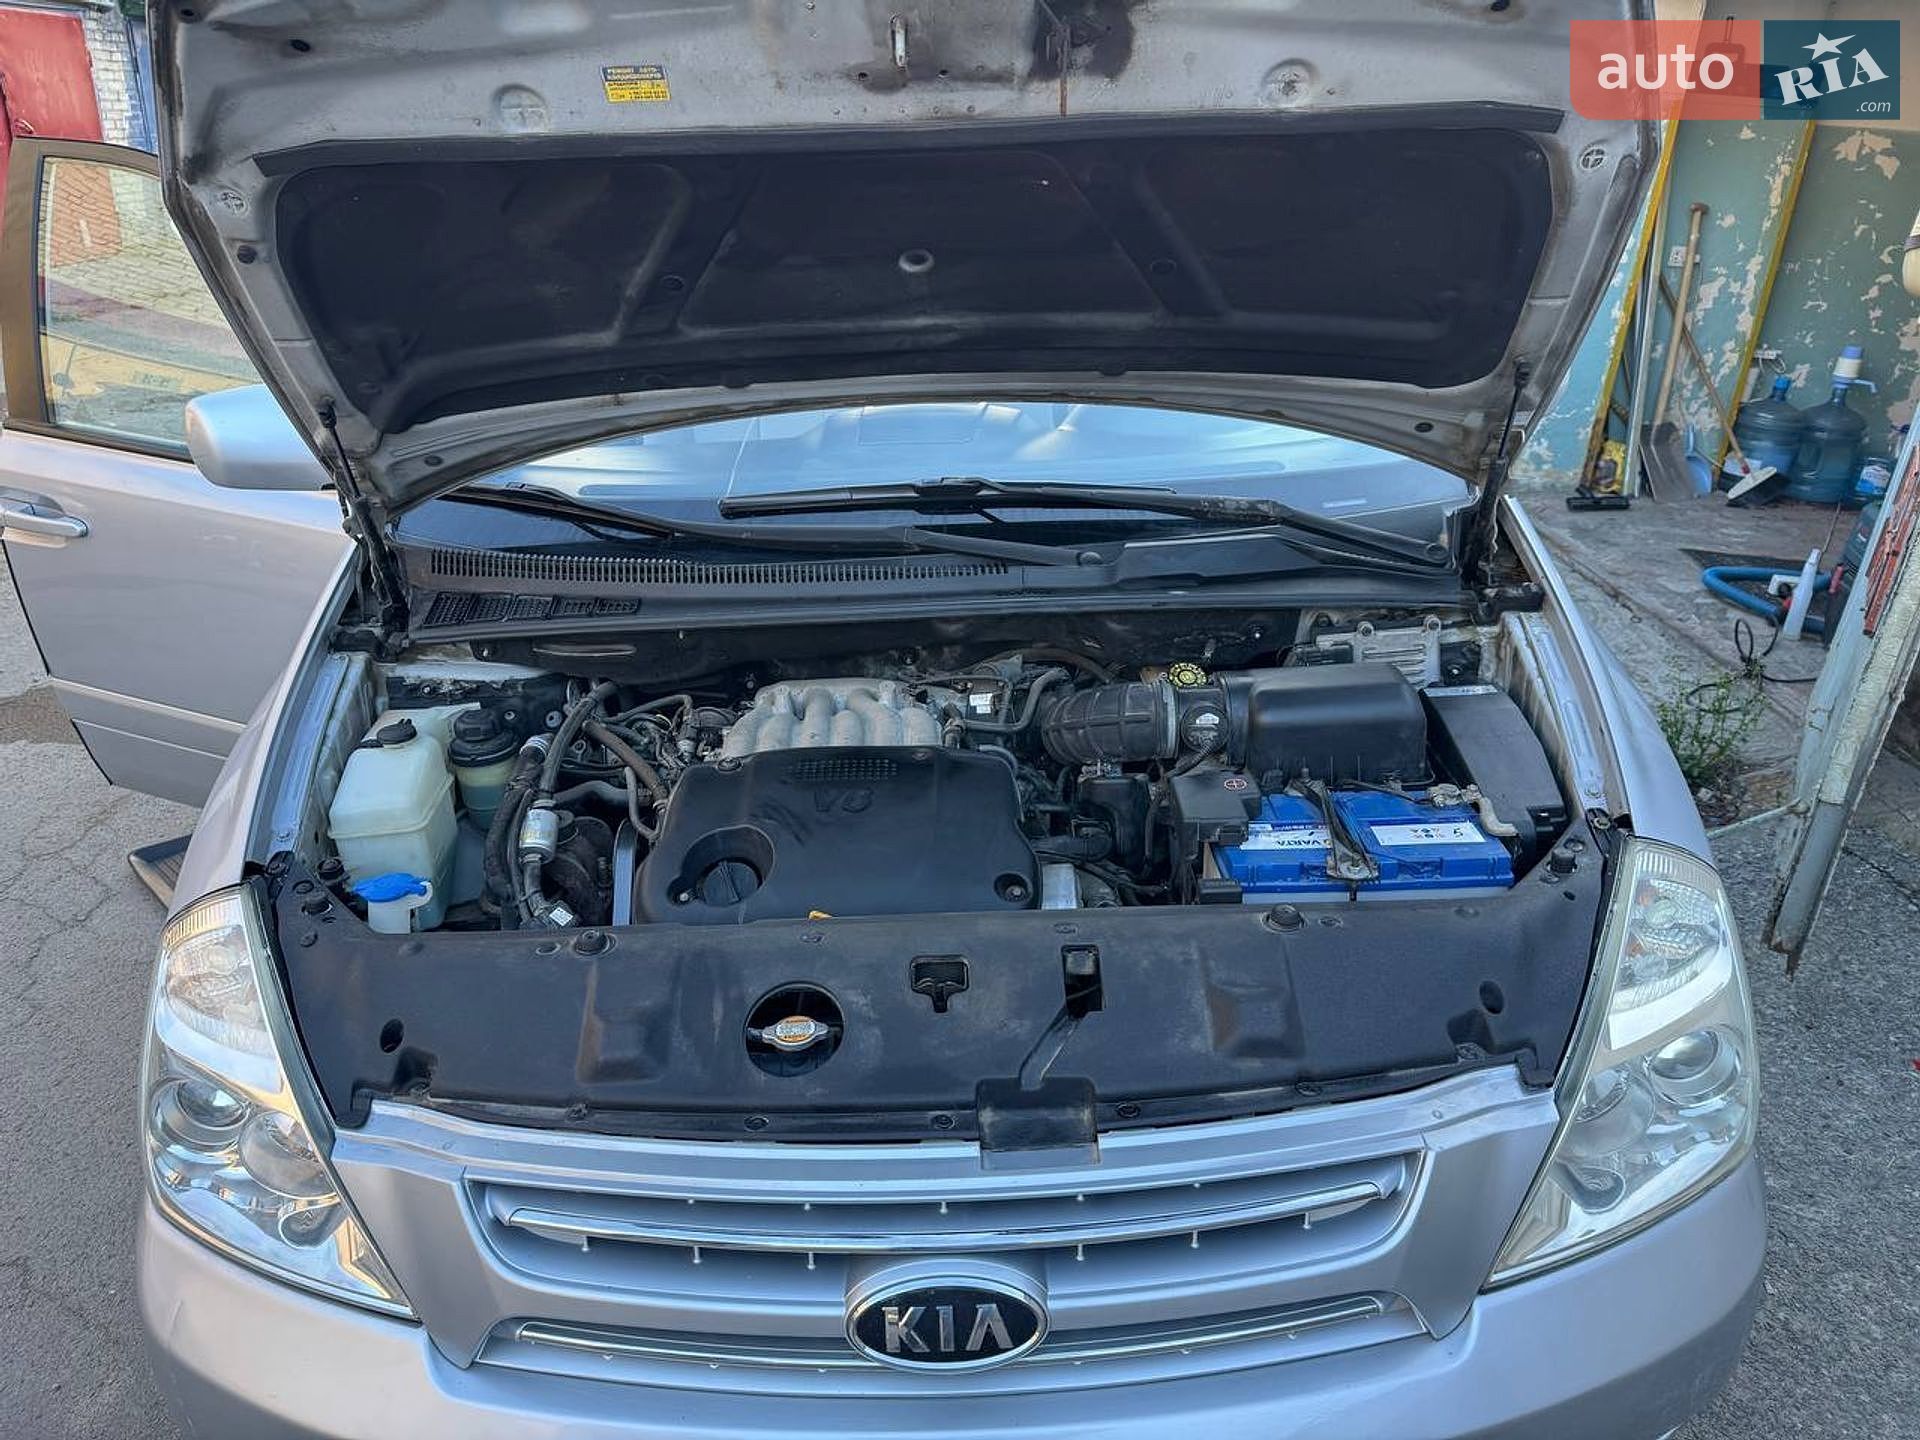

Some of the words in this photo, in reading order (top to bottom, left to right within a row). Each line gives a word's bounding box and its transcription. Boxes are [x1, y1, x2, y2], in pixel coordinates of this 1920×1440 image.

[814, 787, 874, 814] V6
[1275, 838, 1322, 848] VARTA
[882, 1303, 1016, 1353] KIA
